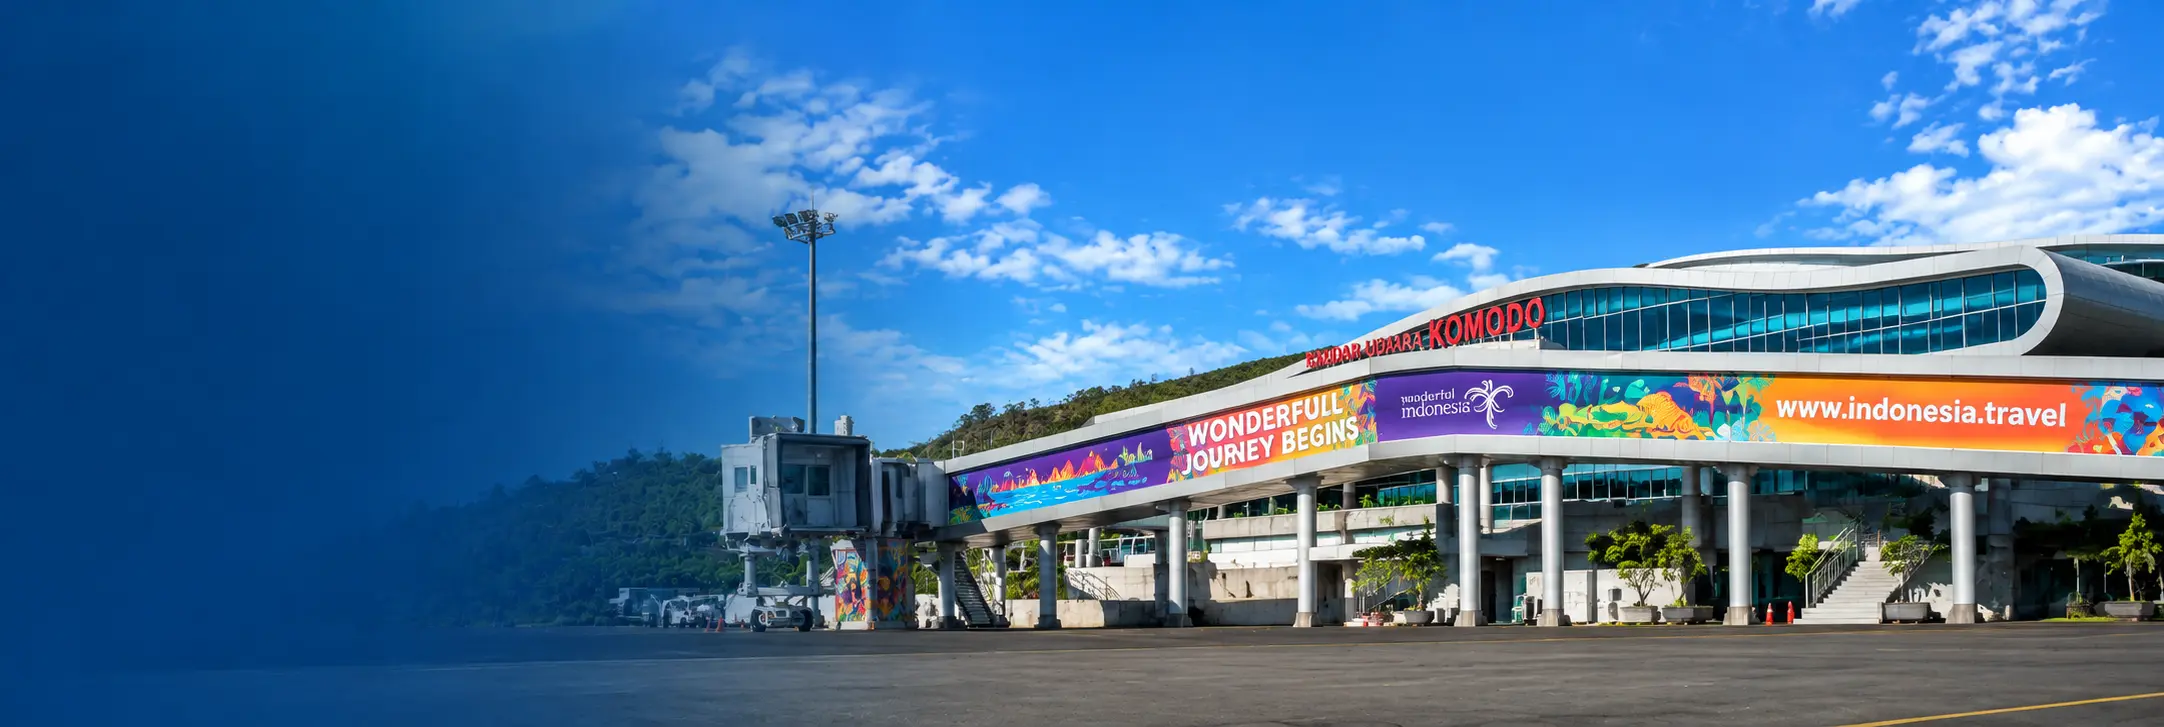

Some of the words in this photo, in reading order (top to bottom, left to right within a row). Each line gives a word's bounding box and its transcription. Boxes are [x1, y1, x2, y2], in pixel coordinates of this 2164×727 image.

[1428, 297, 1545, 349] KOMODO
[1187, 392, 1344, 447] WONDERFULL
[1401, 400, 1471, 418] indonesia
[1776, 396, 2066, 427] www.indonesia.travel
[1181, 434, 1275, 476] JOURNEY
[1281, 416, 1360, 454] BEGINS
